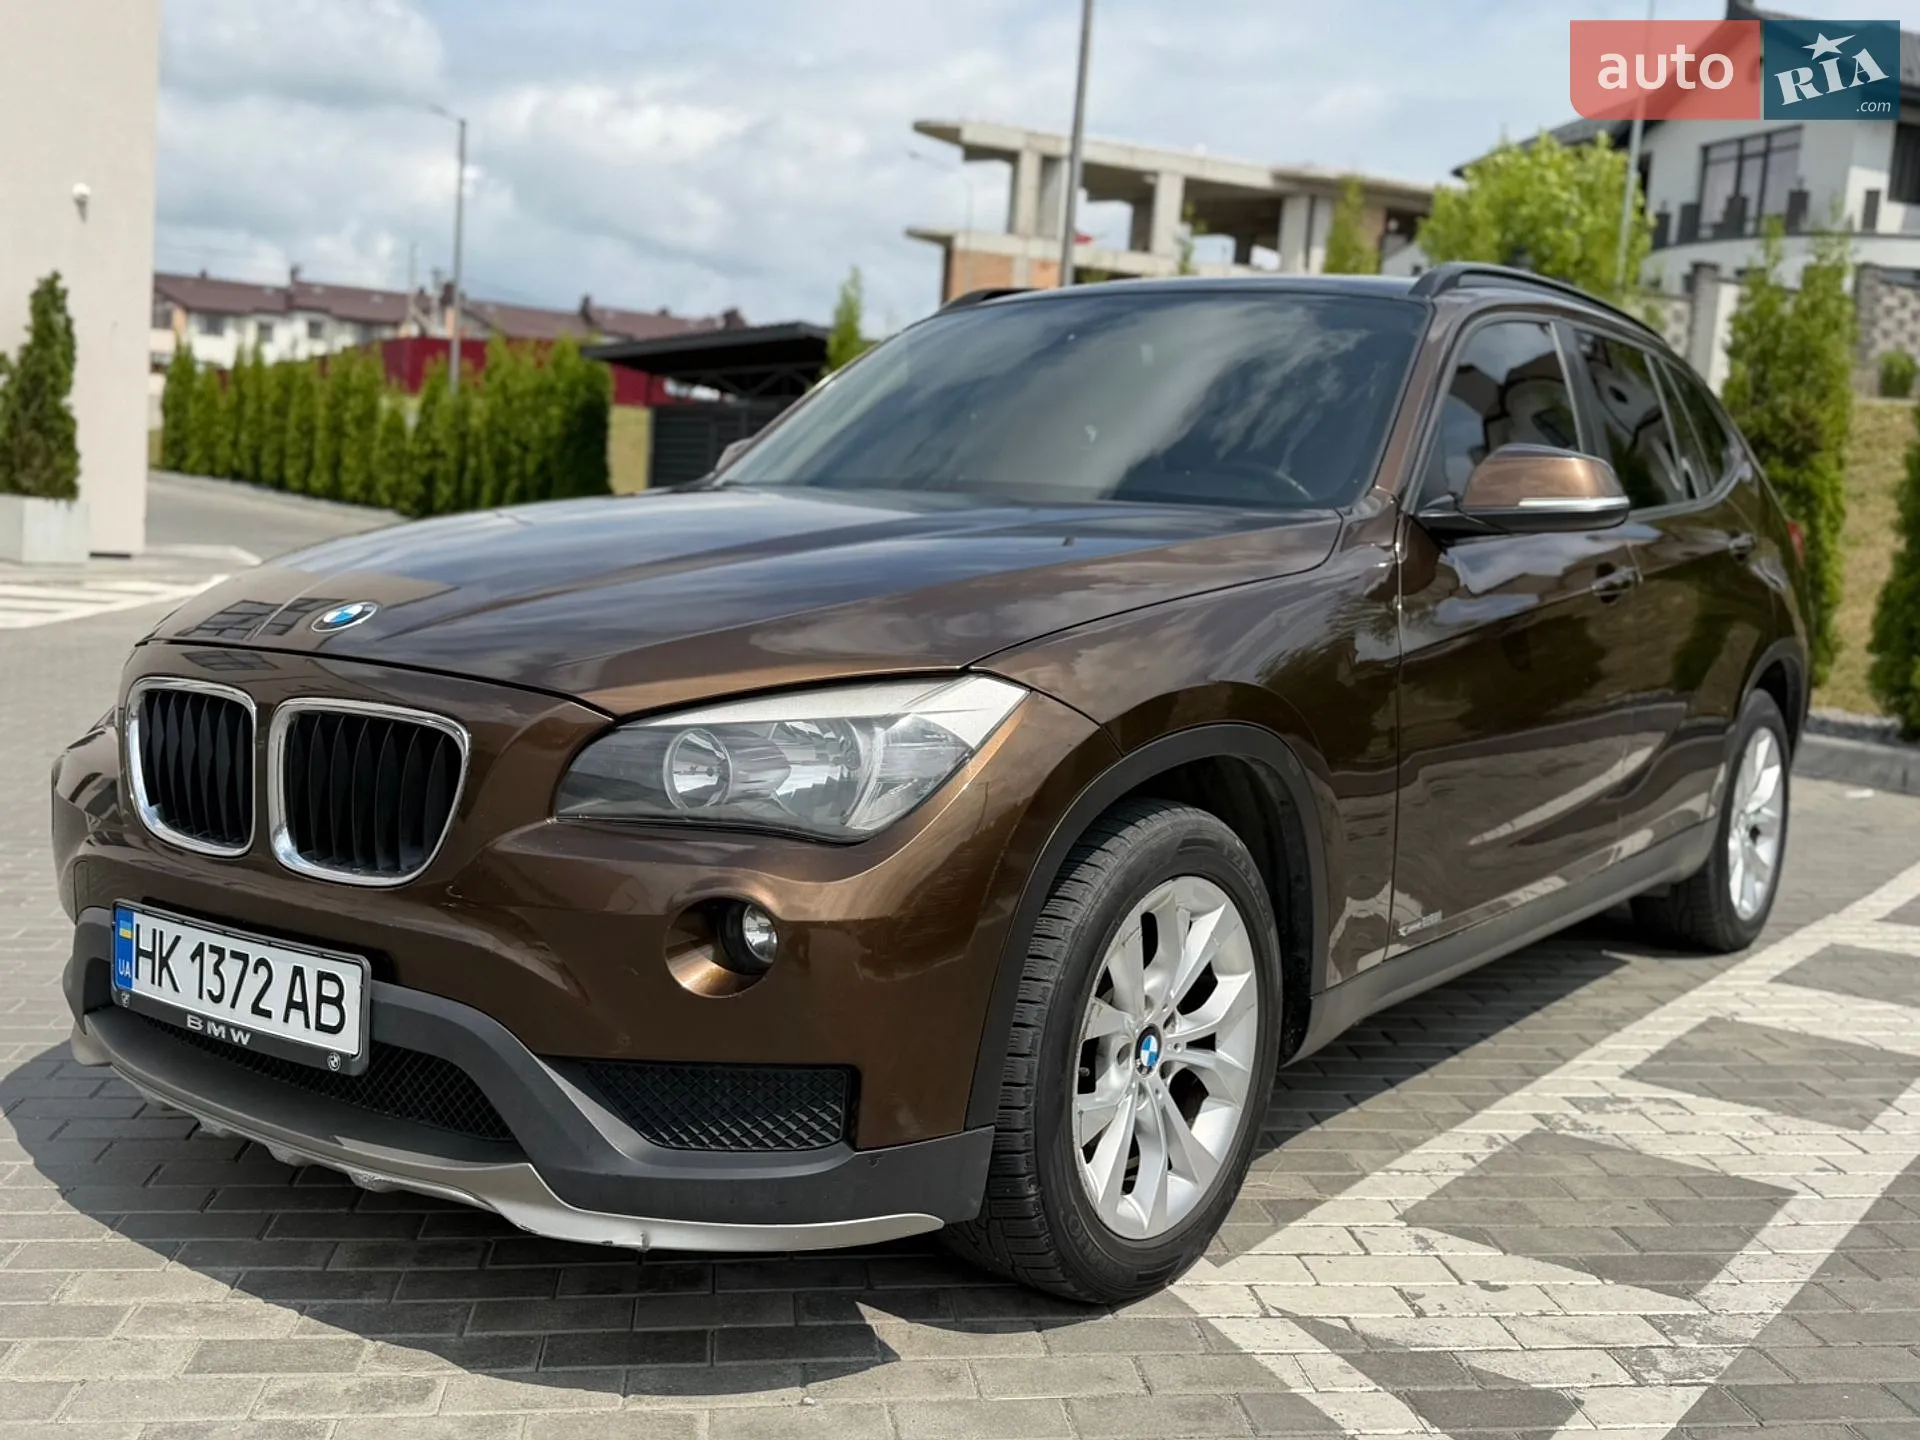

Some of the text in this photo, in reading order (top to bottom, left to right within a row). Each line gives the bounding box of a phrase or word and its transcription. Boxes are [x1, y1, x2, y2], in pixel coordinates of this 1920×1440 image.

[118, 958, 132, 978] UA
[135, 923, 346, 1035] HK 1372 AB
[186, 1013, 251, 1046] BMW
